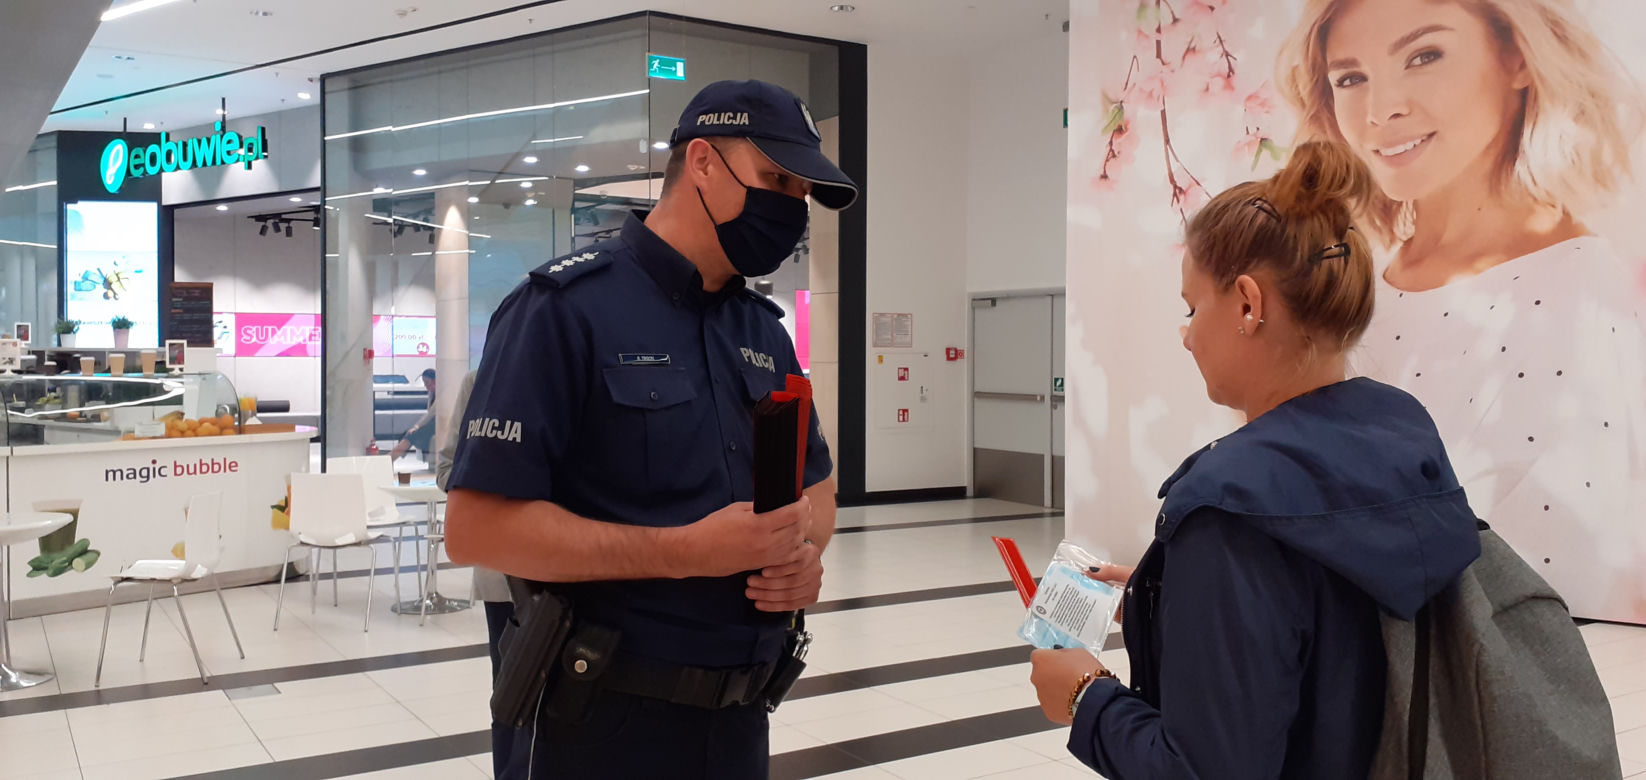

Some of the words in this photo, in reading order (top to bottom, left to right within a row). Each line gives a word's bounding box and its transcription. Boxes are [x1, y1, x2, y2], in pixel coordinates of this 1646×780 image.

[697, 112, 749, 125] POLICJA
[129, 120, 265, 177] eobuwie.pl
[241, 325, 321, 345] SUMME
[740, 347, 776, 373] PLICA
[105, 459, 168, 483] magic
[173, 457, 239, 477] bubble
